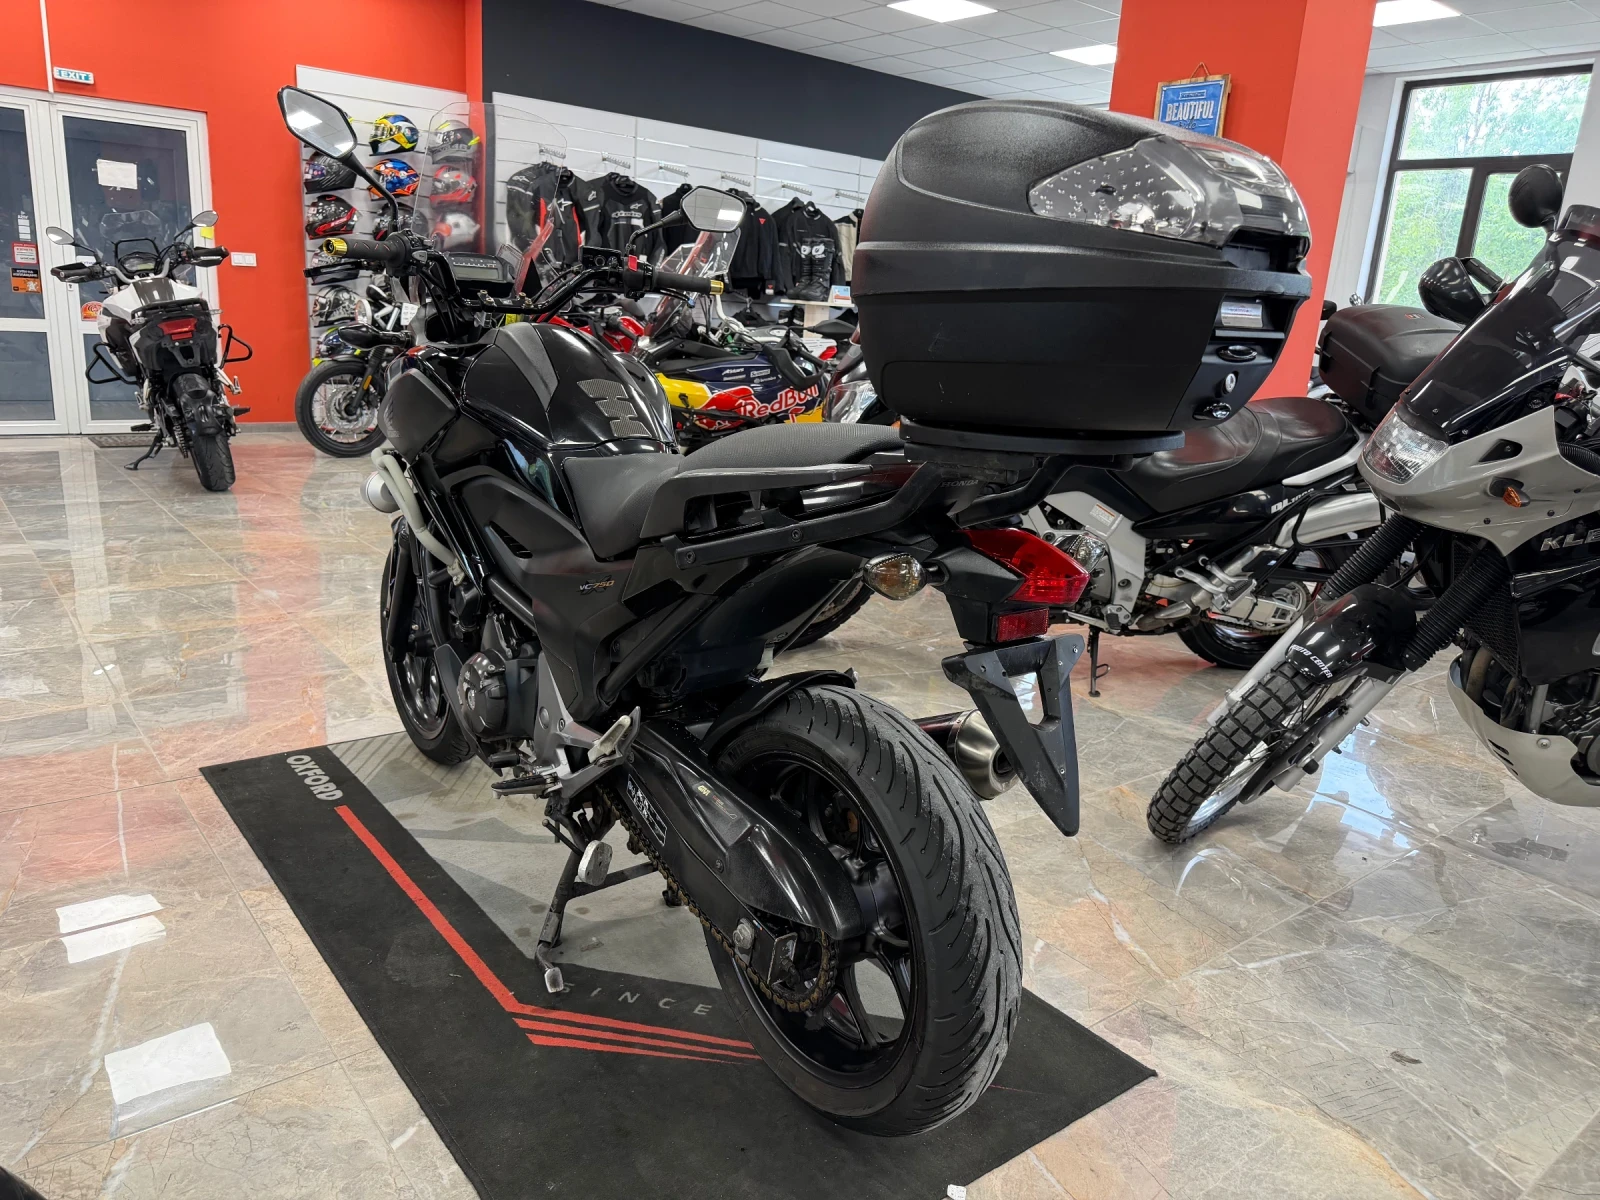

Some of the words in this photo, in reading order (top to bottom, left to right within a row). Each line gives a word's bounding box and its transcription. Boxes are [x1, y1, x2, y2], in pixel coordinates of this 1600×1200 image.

[61, 69, 87, 80] EXIT
[1166, 101, 1214, 121] BEAUTIFUL
[940, 480, 979, 488] HONDA
[1540, 529, 1600, 551] KLE
[1310, 655, 1333, 679] CENTER
[286, 755, 343, 800] OXFORD
[561, 982, 712, 1015] SINCE
